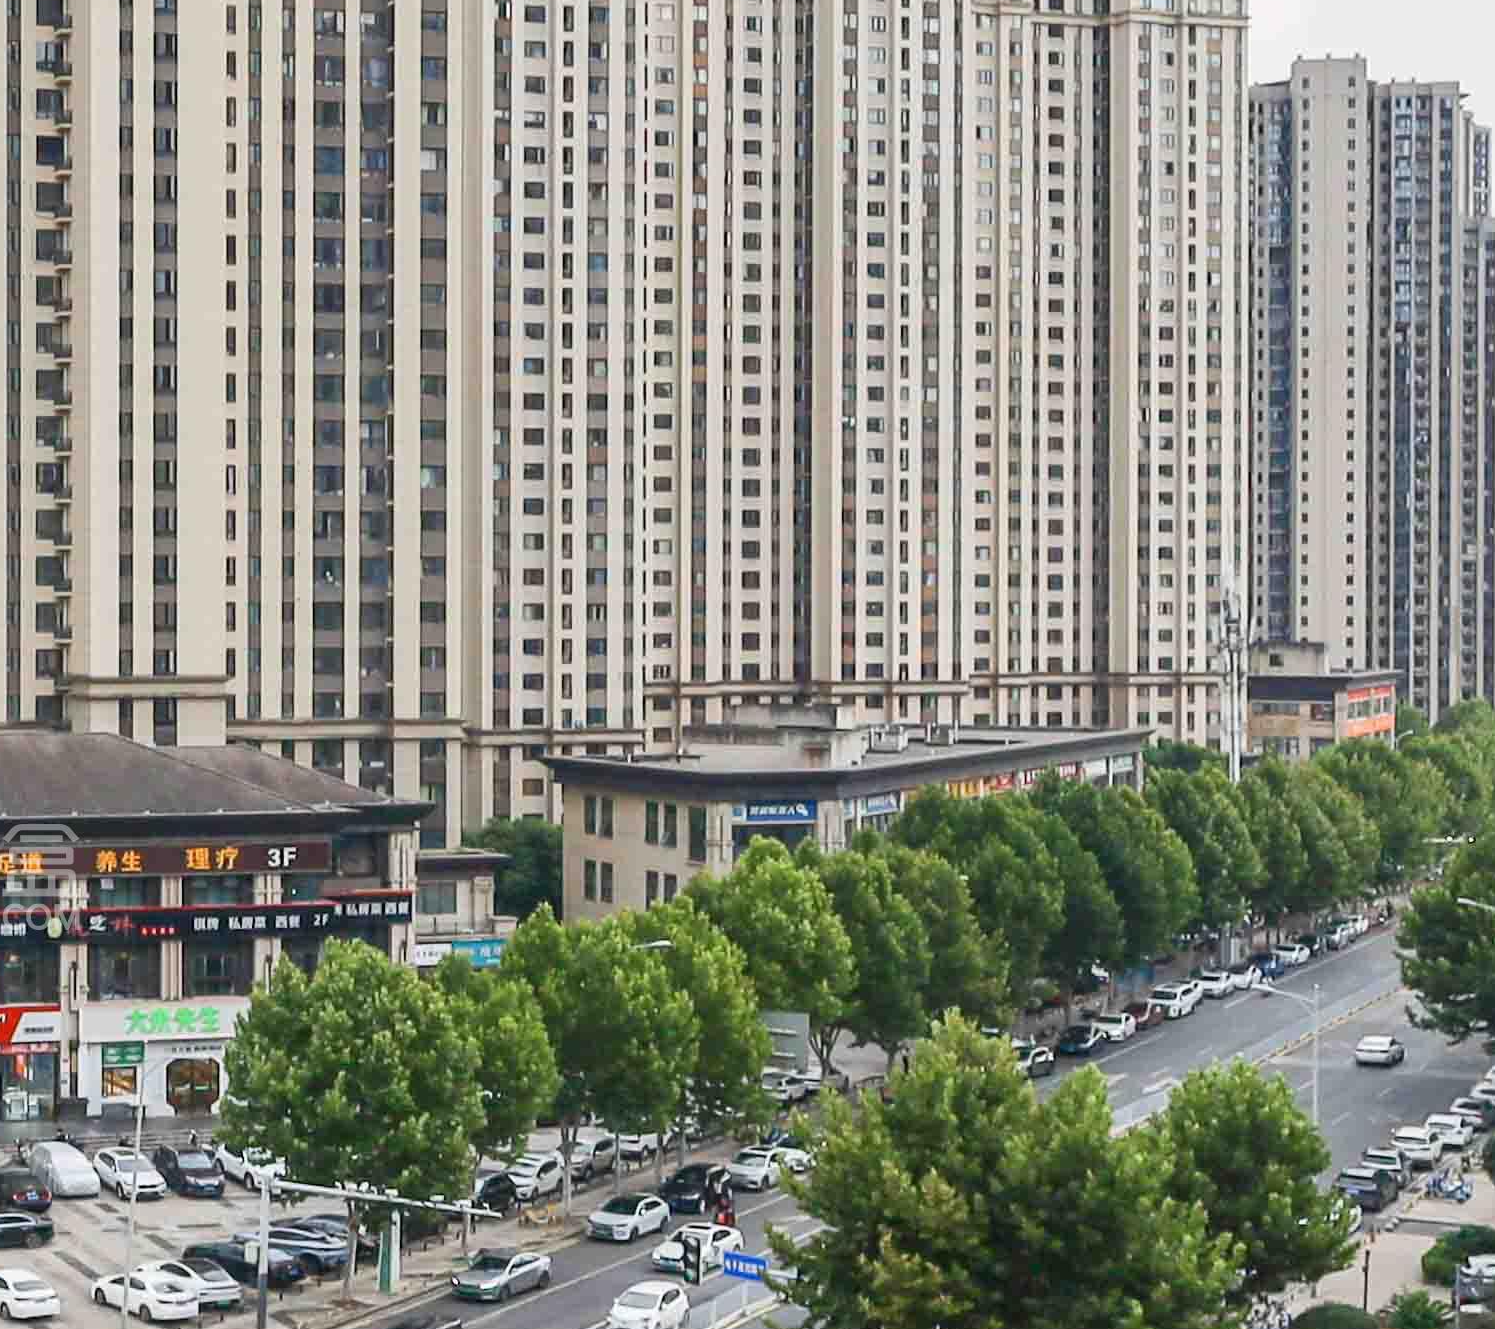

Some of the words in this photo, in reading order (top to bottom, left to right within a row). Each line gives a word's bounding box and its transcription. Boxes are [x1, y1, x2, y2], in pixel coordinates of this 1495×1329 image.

[95, 848, 143, 873] 养生
[185, 846, 240, 871] 理疗
[267, 846, 298, 868] 3F
